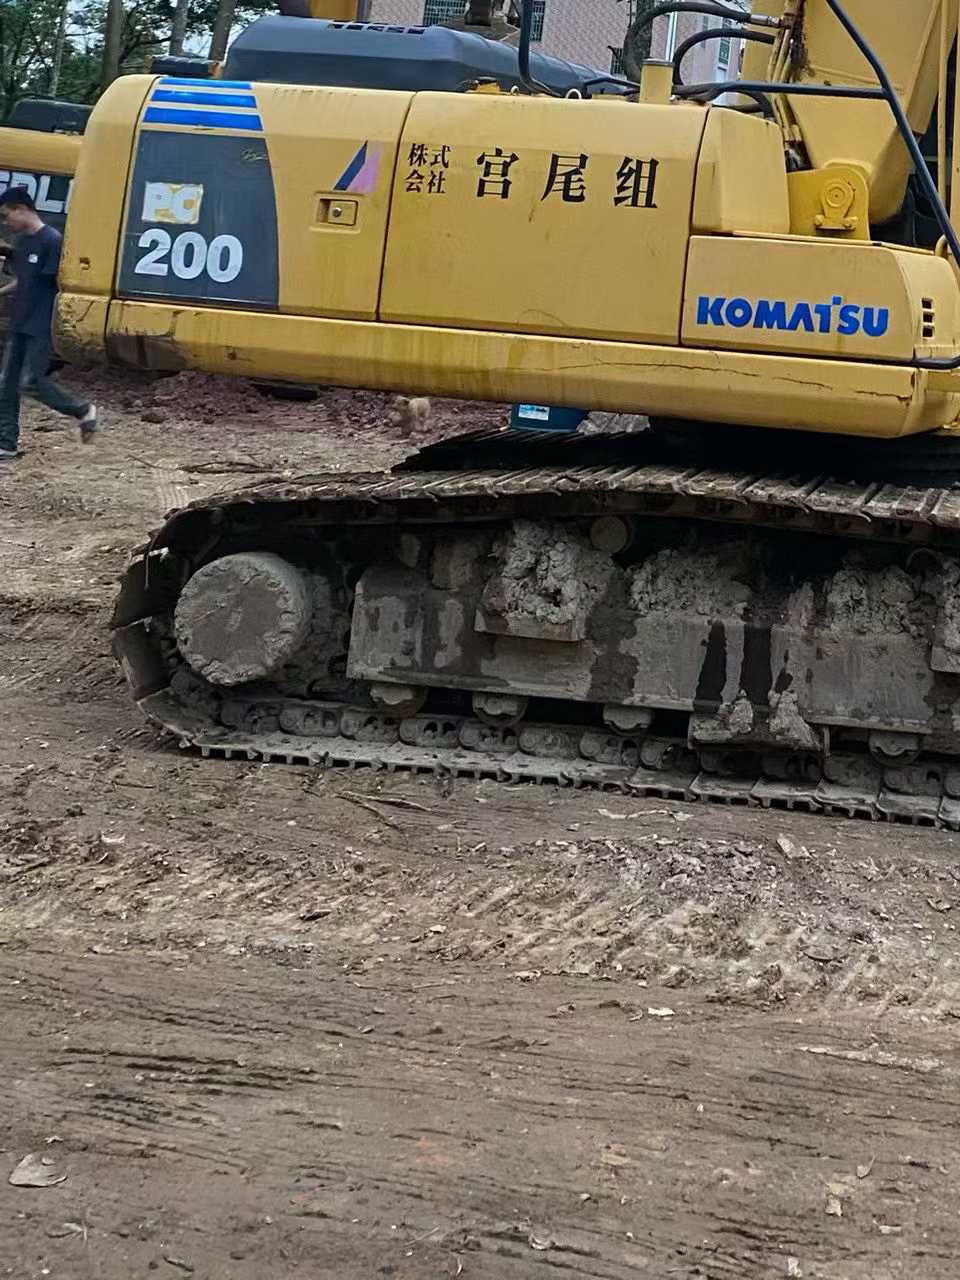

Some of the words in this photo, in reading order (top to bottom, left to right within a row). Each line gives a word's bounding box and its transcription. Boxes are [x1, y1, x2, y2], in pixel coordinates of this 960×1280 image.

[407, 143, 451, 169] 株式
[141, 182, 201, 224] PC
[404, 170, 447, 194] 会社
[134, 228, 243, 283] 200
[696, 295, 889, 337] KOMATSU
